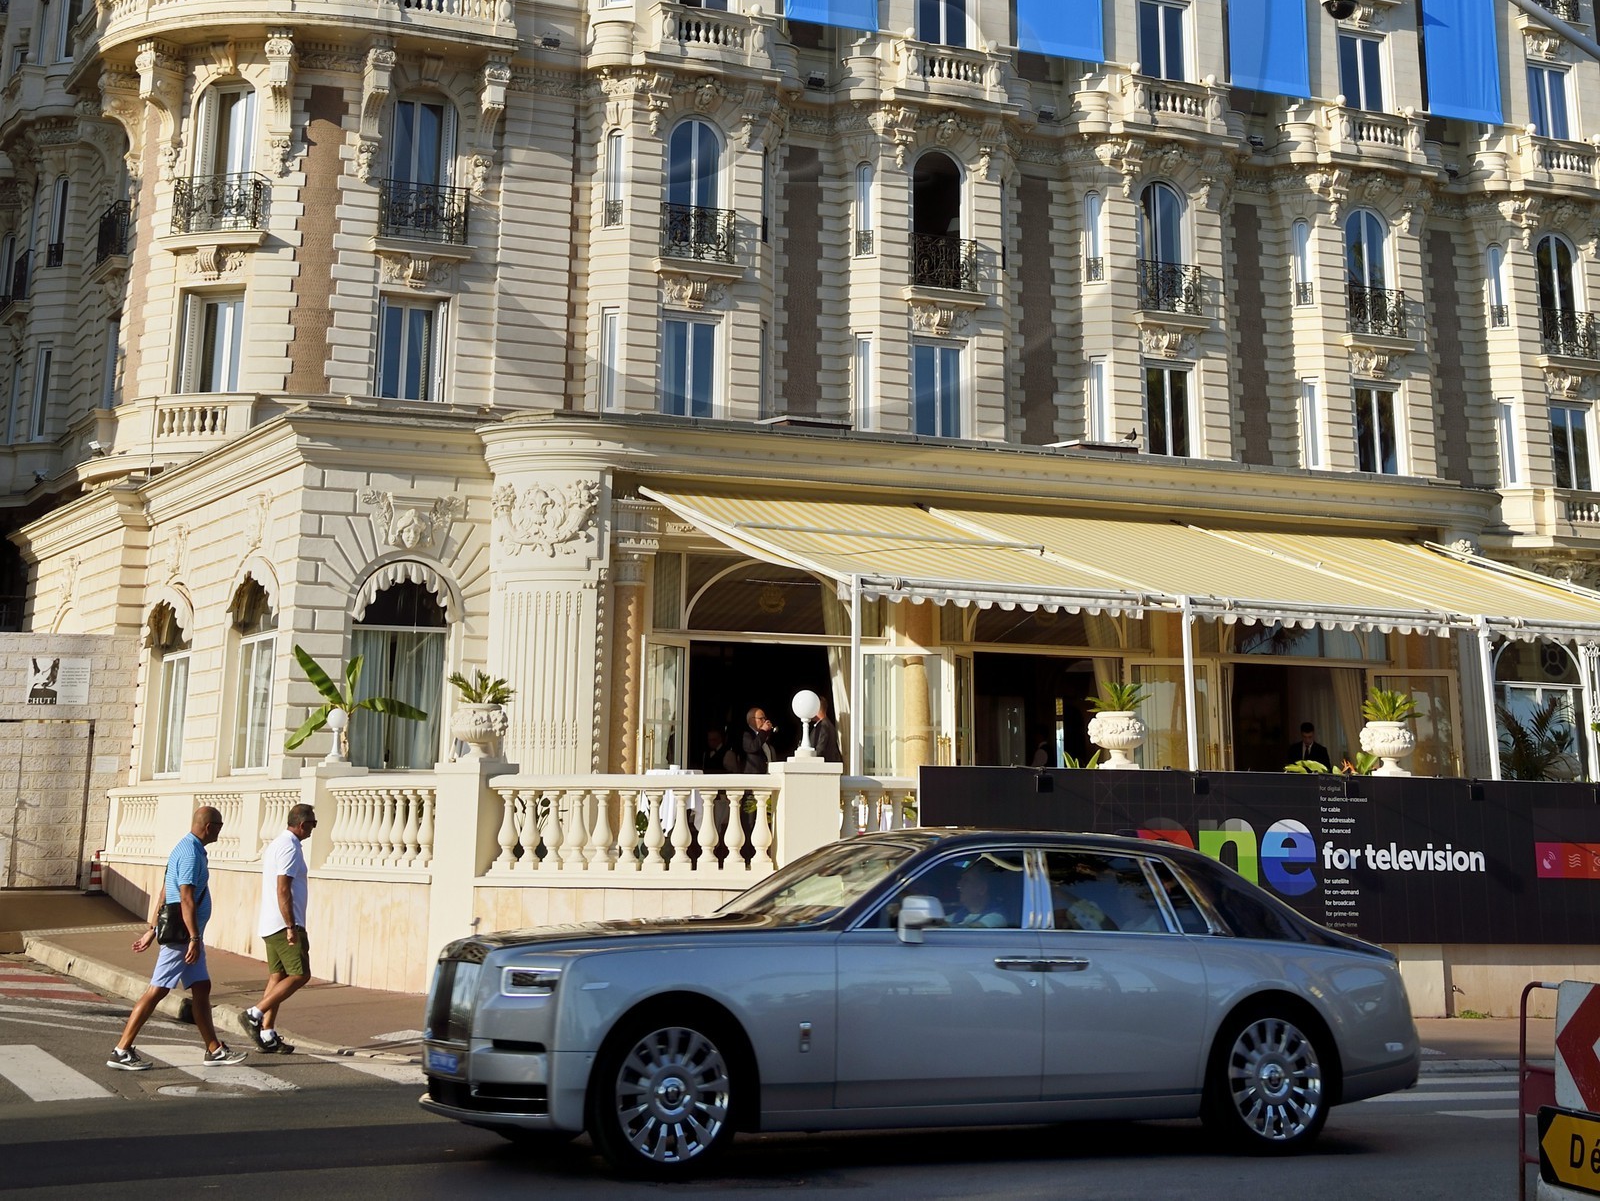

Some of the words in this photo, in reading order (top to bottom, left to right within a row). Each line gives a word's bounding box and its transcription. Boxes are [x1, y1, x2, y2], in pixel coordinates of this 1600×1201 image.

[1327, 785, 1341, 793] digital
[1322, 841, 1361, 870] for
[1365, 842, 1486, 872] television
